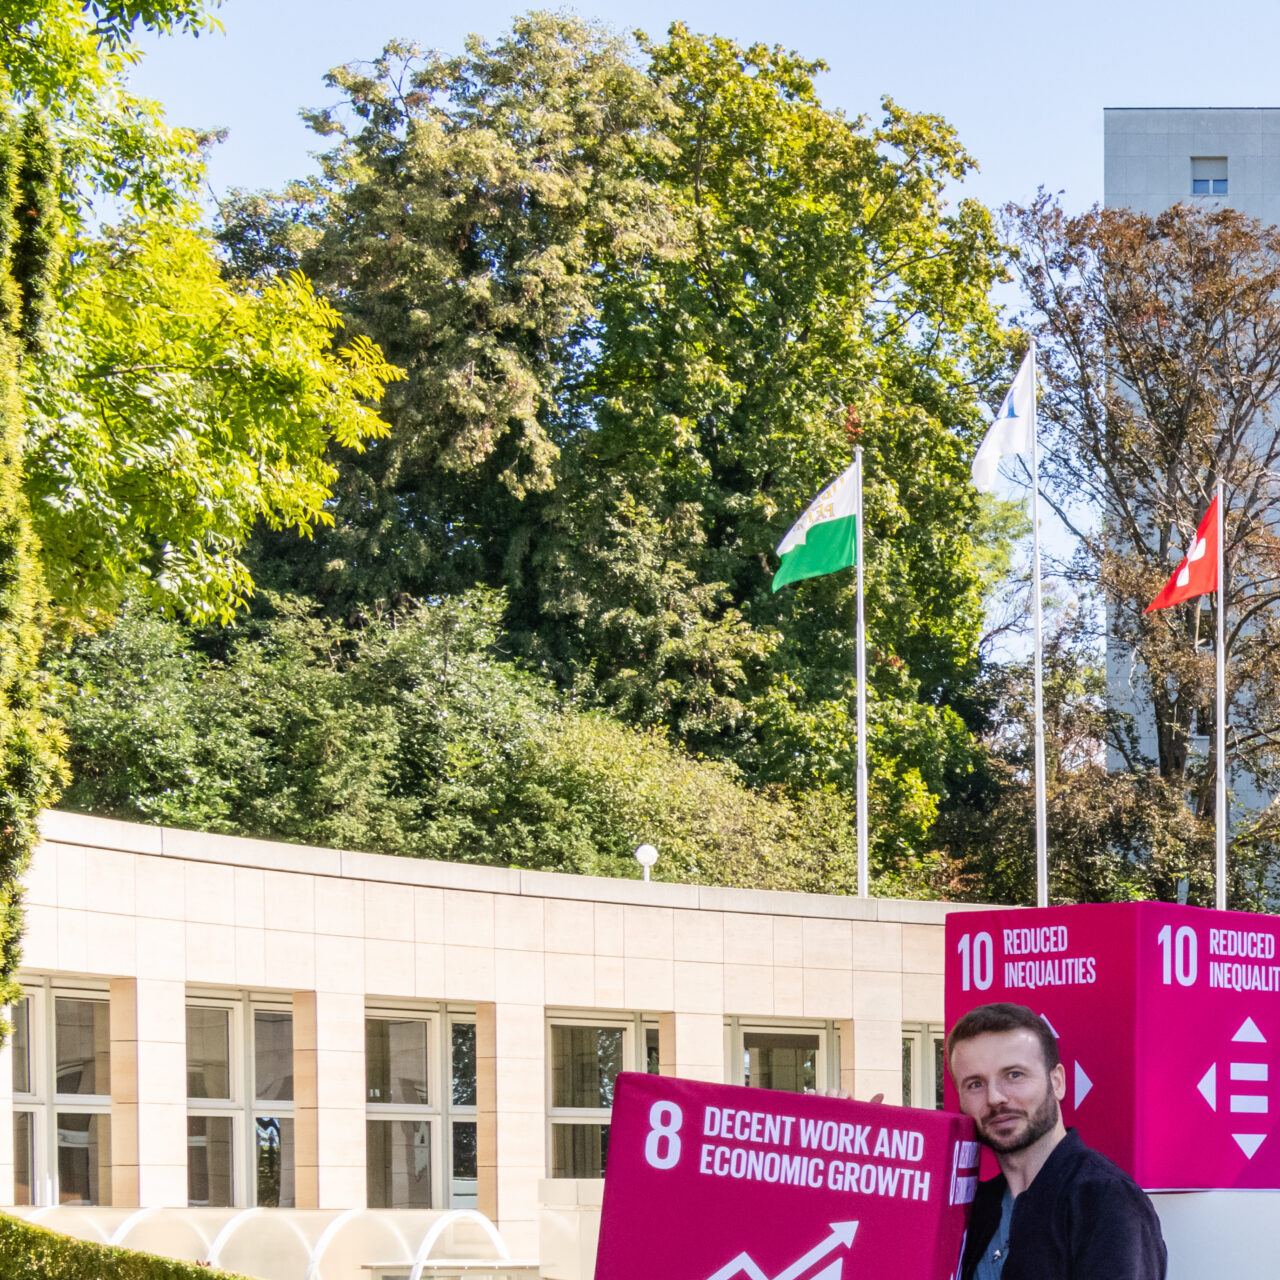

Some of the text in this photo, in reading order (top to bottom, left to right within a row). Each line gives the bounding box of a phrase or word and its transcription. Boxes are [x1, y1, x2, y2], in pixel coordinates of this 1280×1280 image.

[958, 932, 993, 991] 10
[1003, 926, 1067, 954] REDUCED
[1158, 925, 1197, 986] 10
[1210, 929, 1274, 959] REDUCED
[1005, 957, 1096, 989] INEQUALITIES
[645, 1101, 682, 1169] 8
[704, 1106, 924, 1161] DECENT WORK AND
[700, 1144, 824, 1188] ECONOMIC
[828, 1160, 930, 1201] GROWTH
